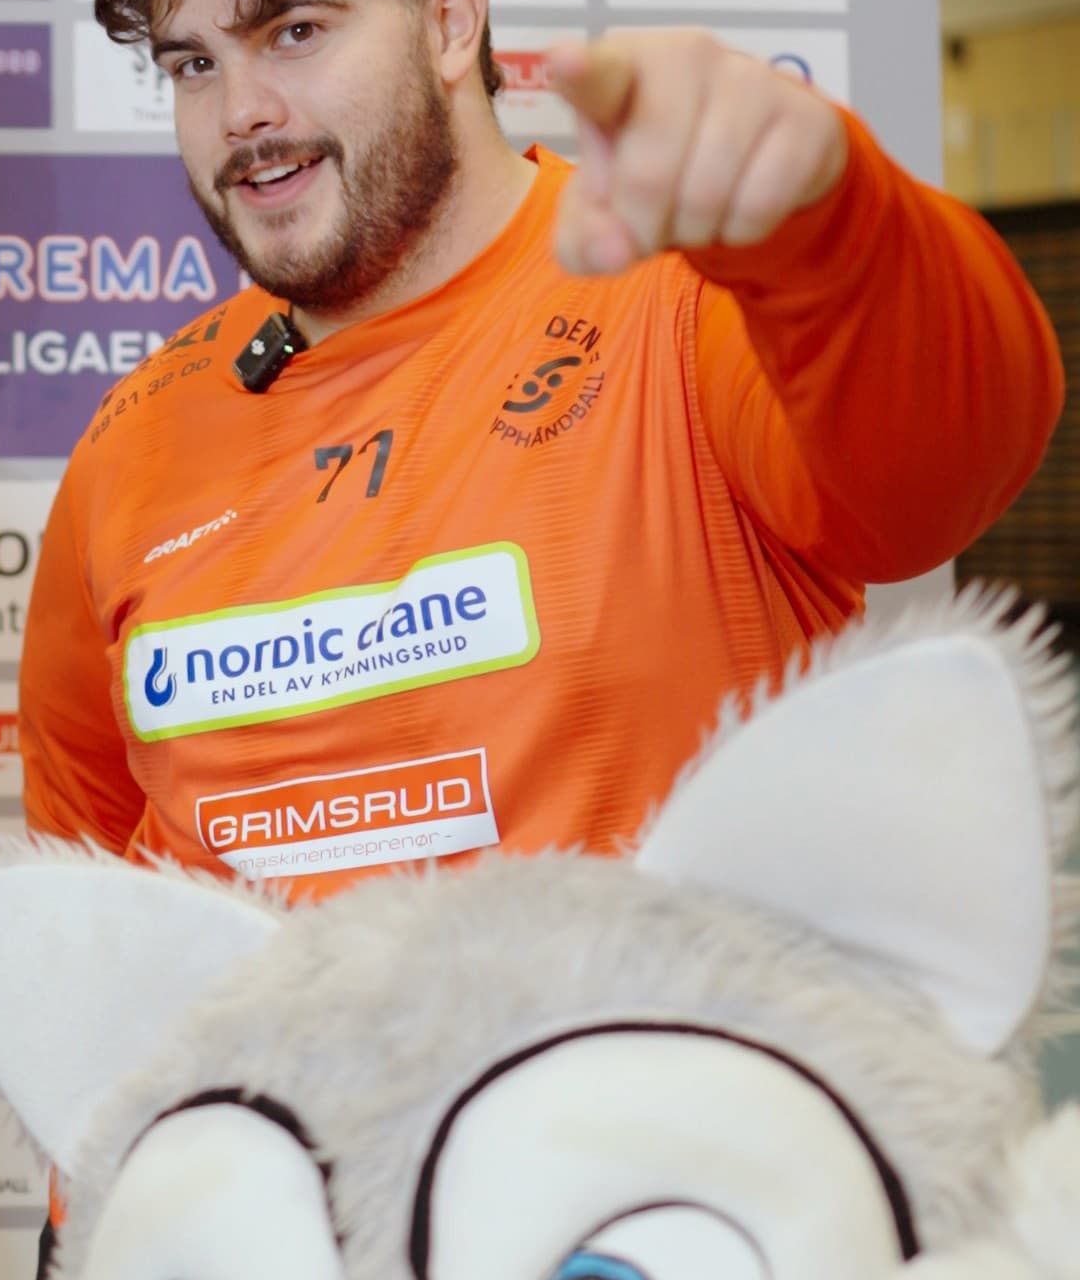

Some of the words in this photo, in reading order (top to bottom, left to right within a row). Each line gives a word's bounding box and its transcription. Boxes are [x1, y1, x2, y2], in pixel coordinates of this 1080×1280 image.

[314, 429, 394, 504] 71
[186, 618, 343, 683] nordic
[356, 585, 488, 651] crane
[211, 687, 236, 705] EN
[243, 681, 277, 700] DEL
[286, 675, 314, 693] AV
[320, 634, 468, 687] KYNNINGSRUD
[208, 777, 471, 848] GRIMSRUD
